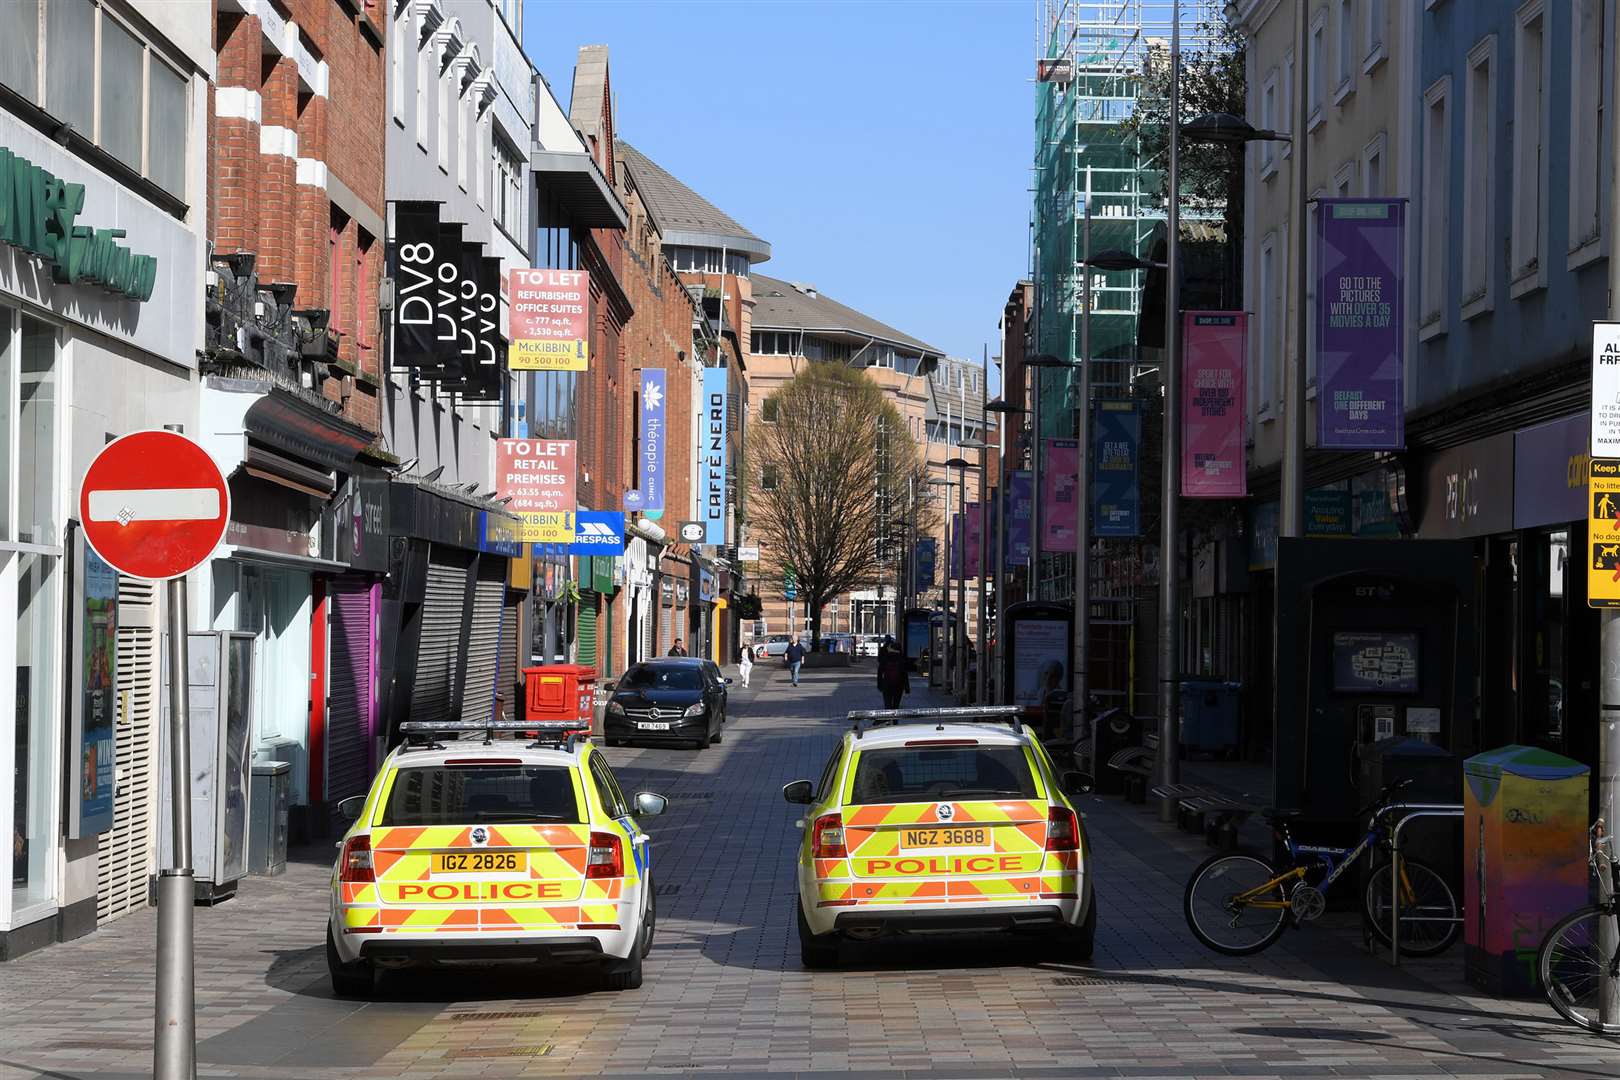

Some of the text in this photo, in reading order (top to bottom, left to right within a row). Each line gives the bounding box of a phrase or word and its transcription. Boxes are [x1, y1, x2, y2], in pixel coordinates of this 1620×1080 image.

[399, 242, 435, 324] DV8
[517, 271, 582, 287] TO LET
[1340, 277, 1383, 289] GO TO THE
[517, 290, 580, 301] REFURBISHED
[1340, 290, 1380, 302] PICTURES
[515, 303, 583, 314] OFFICE SUITES
[1330, 302, 1353, 314] WITH
[1354, 303, 1377, 314] OVER
[1330, 315, 1391, 327] MOVIES A DAY
[518, 342, 571, 353] McKIBBIN
[519, 357, 570, 365] 90 500 100
[709, 393, 723, 451] NERO
[503, 441, 570, 457] TO LET
[513, 459, 559, 471] RETAIL
[1594, 464, 1617, 474] Keep
[506, 473, 567, 485] PREMISES
[517, 488, 540, 497] 63.55
[541, 490, 565, 498] sq.m.
[513, 498, 533, 509] (684
[542, 529, 558, 537] 100
[576, 535, 620, 544] RESPASS
[1354, 586, 1377, 597] BT
[907, 830, 985, 846] NGZ 3688
[441, 855, 517, 870] IGZ 2826
[867, 856, 1023, 874] POLICE
[398, 883, 563, 899] POLICE
